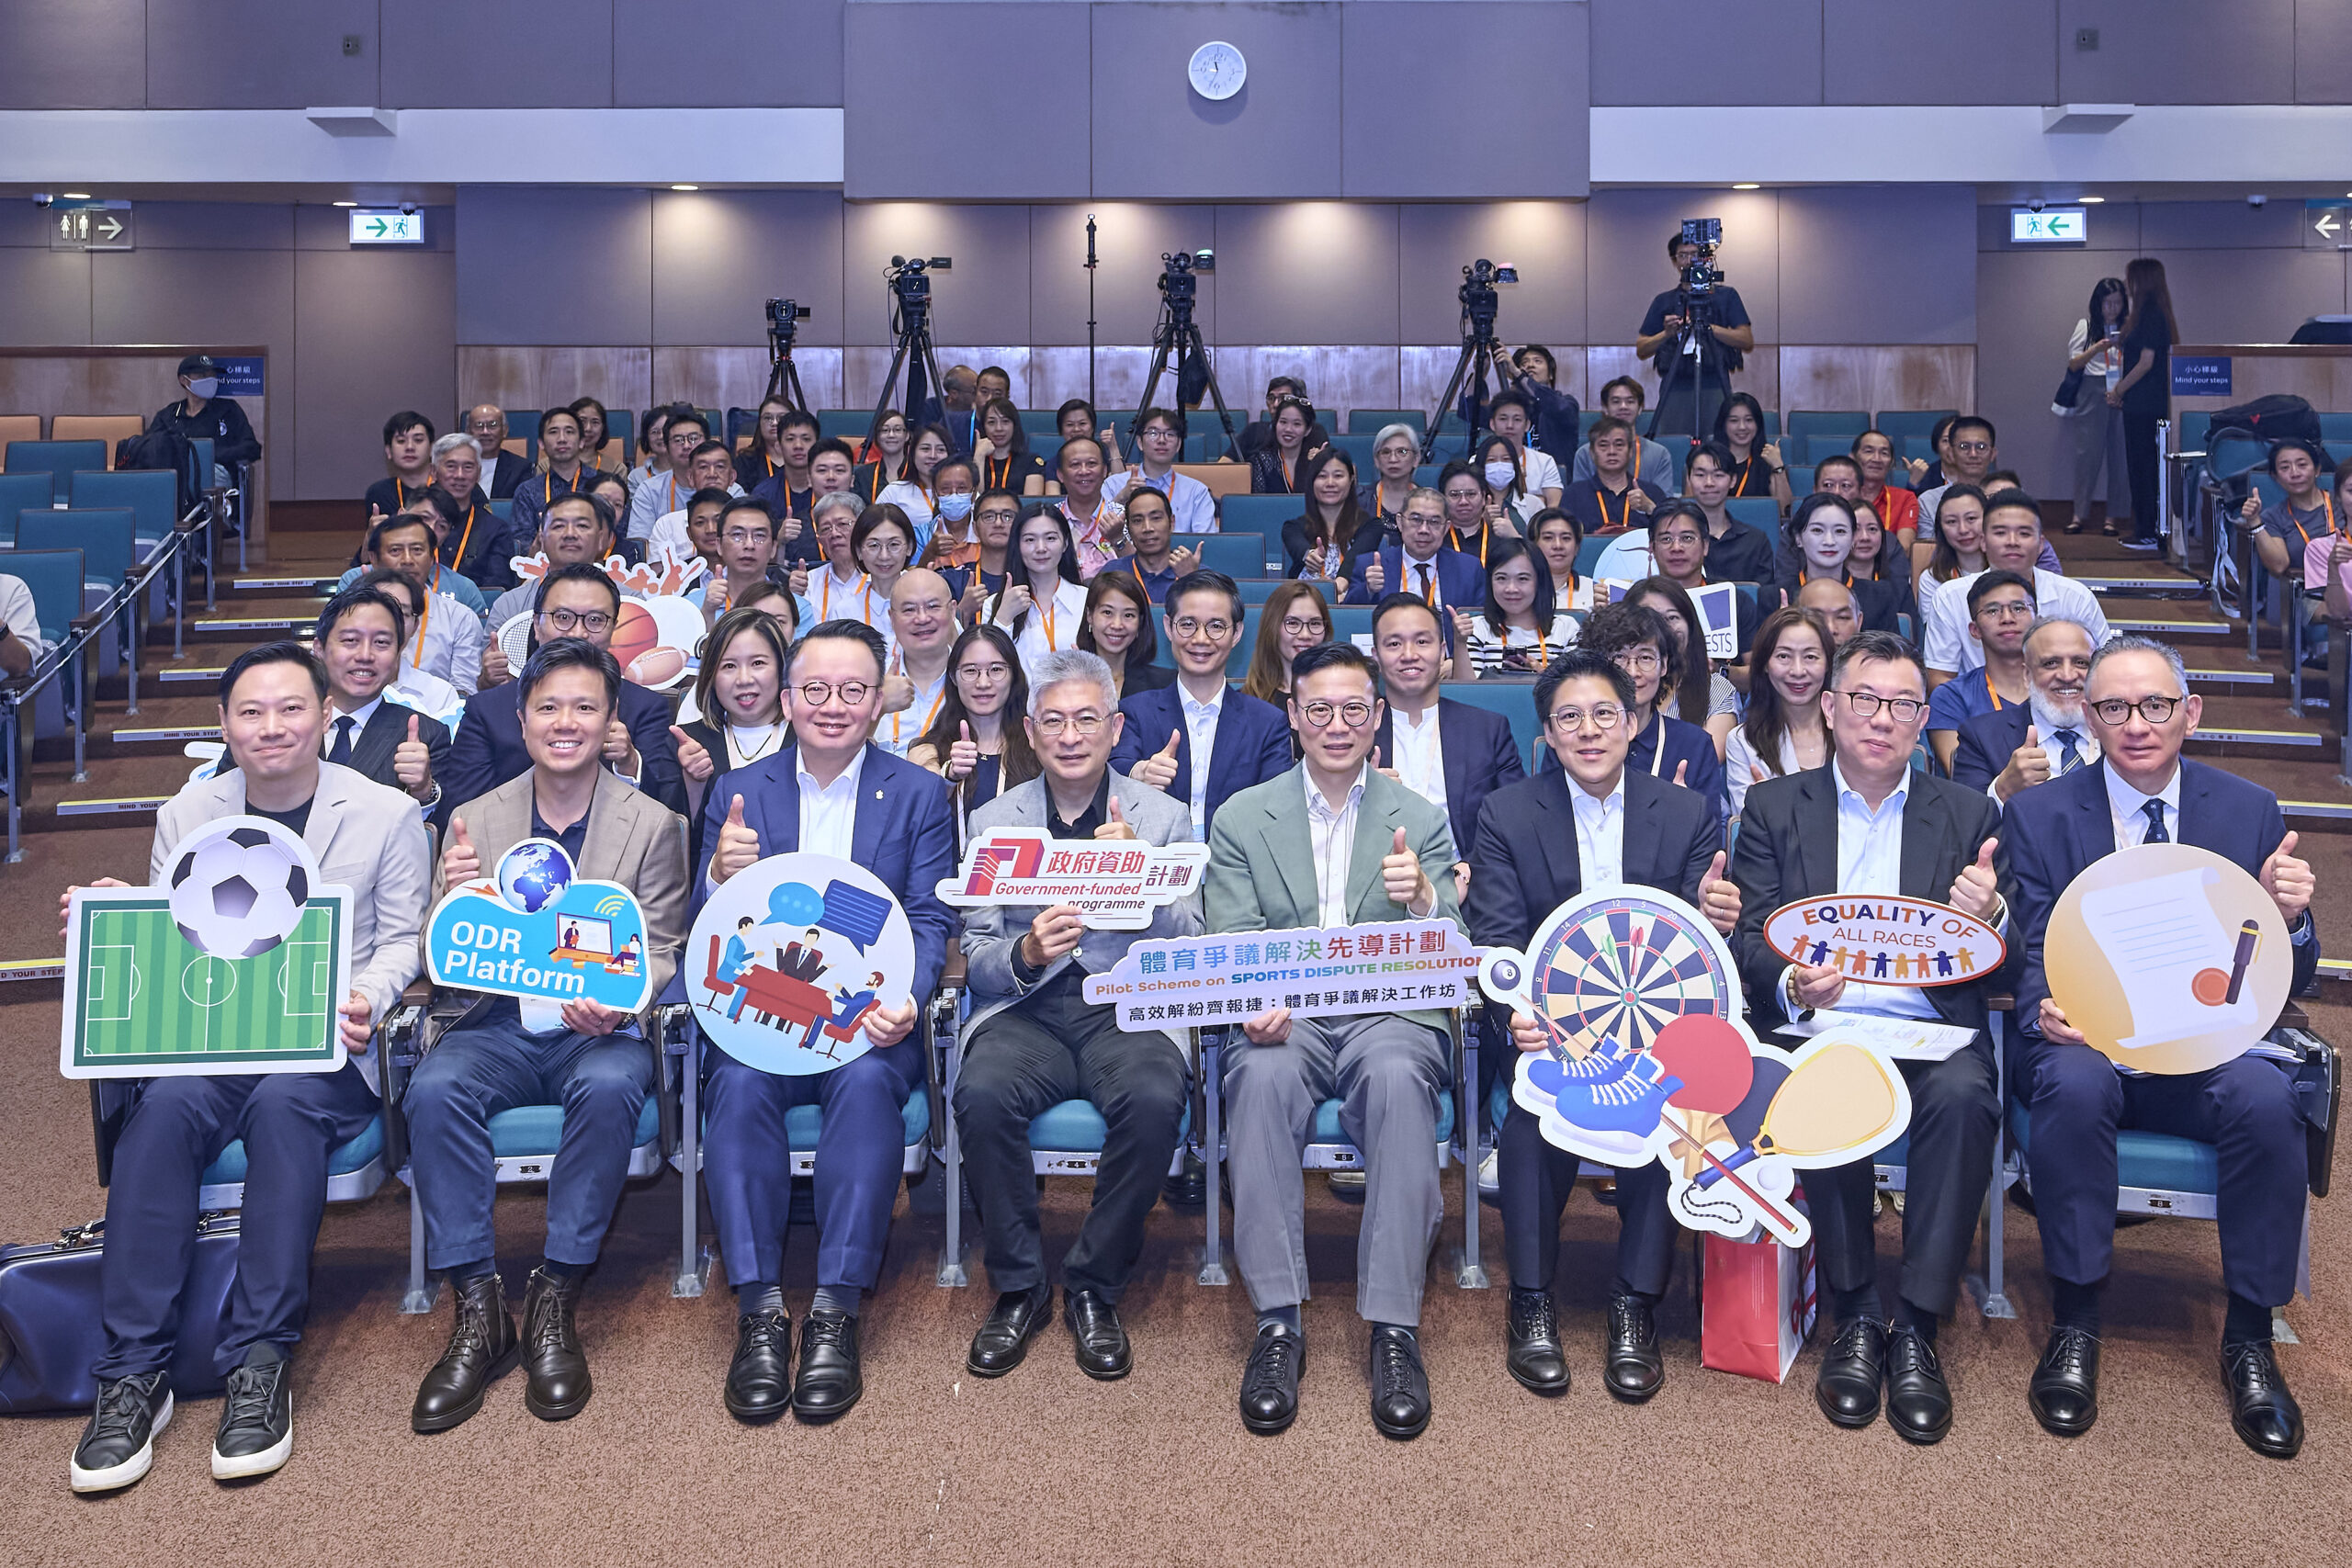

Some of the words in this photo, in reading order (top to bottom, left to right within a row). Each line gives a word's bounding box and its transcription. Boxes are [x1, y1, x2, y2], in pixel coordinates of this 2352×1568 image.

[1046, 851, 1147, 874] 政府資助
[1145, 864, 1193, 887] 計劃
[994, 882, 1142, 896] Government-funded
[1611, 899, 1621, 908] 12
[1667, 911, 1678, 919] 20
[1802, 904, 1937, 927] EQUALITY
[1941, 919, 1980, 940] OF
[1561, 921, 1571, 931] 14
[450, 920, 523, 954] ODR
[1832, 927, 1868, 942] ALL
[1872, 931, 1937, 949] RACES
[1139, 929, 1446, 975] 體育爭議解決先導計劃
[1543, 946, 1552, 956] 11
[1706, 951, 1716, 961] 18
[12, 970, 36, 978] YOUR
[40, 968, 63, 976] STEP
[444, 949, 585, 994] Platform
[1507, 968, 1513, 976] 8
[1095, 983, 1134, 996] Pilot
[1138, 978, 1201, 992] Scheme
[1205, 977, 1226, 987] on
[1231, 968, 1300, 985] SPORTS
[1305, 963, 1377, 979] DISPUTE
[1719, 1010, 1727, 1020] 13
